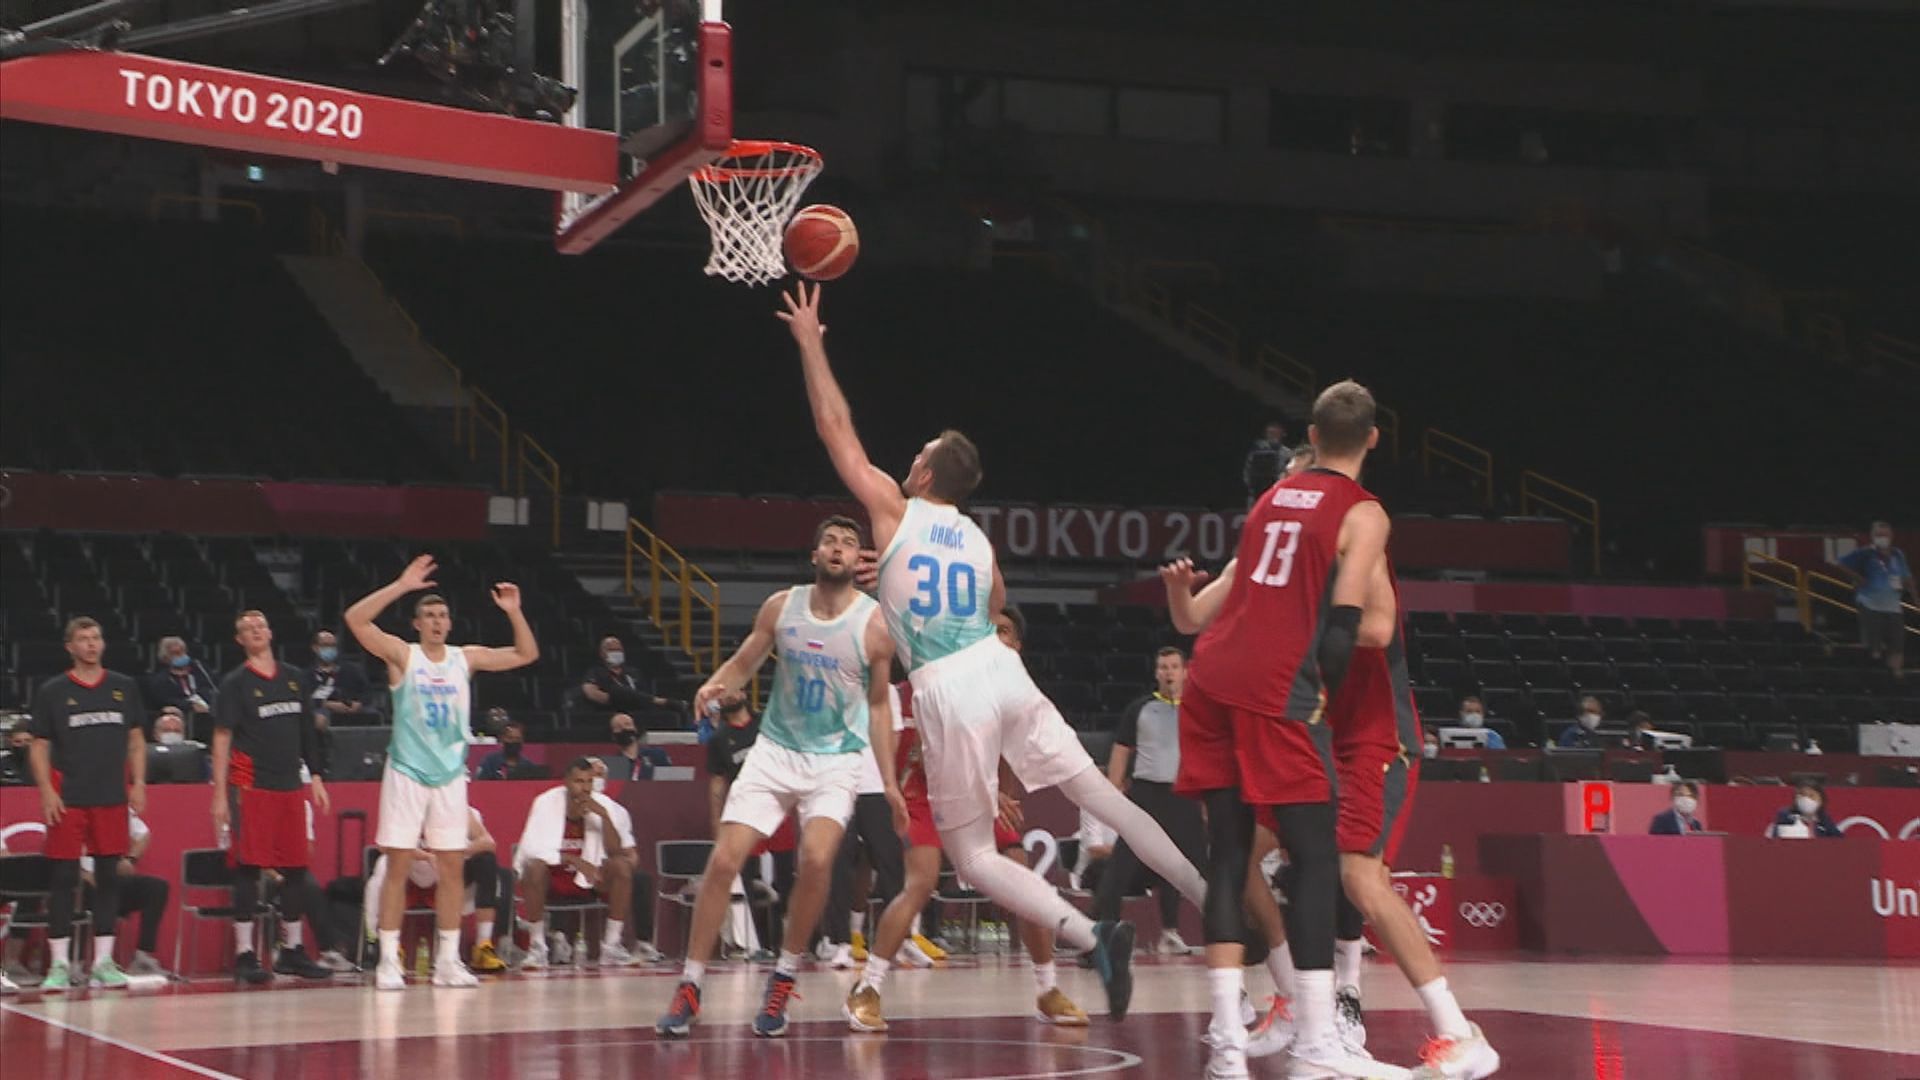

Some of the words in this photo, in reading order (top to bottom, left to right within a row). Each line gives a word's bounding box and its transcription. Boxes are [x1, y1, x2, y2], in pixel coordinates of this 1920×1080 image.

[119, 69, 257, 124] TOKYO
[265, 92, 363, 139] 2020
[969, 506, 1150, 559] TOKYO
[1164, 512, 1247, 560] 20
[1250, 520, 1302, 588] 13
[908, 554, 977, 617] 30
[425, 701, 449, 728] 31
[796, 675, 827, 712] 10
